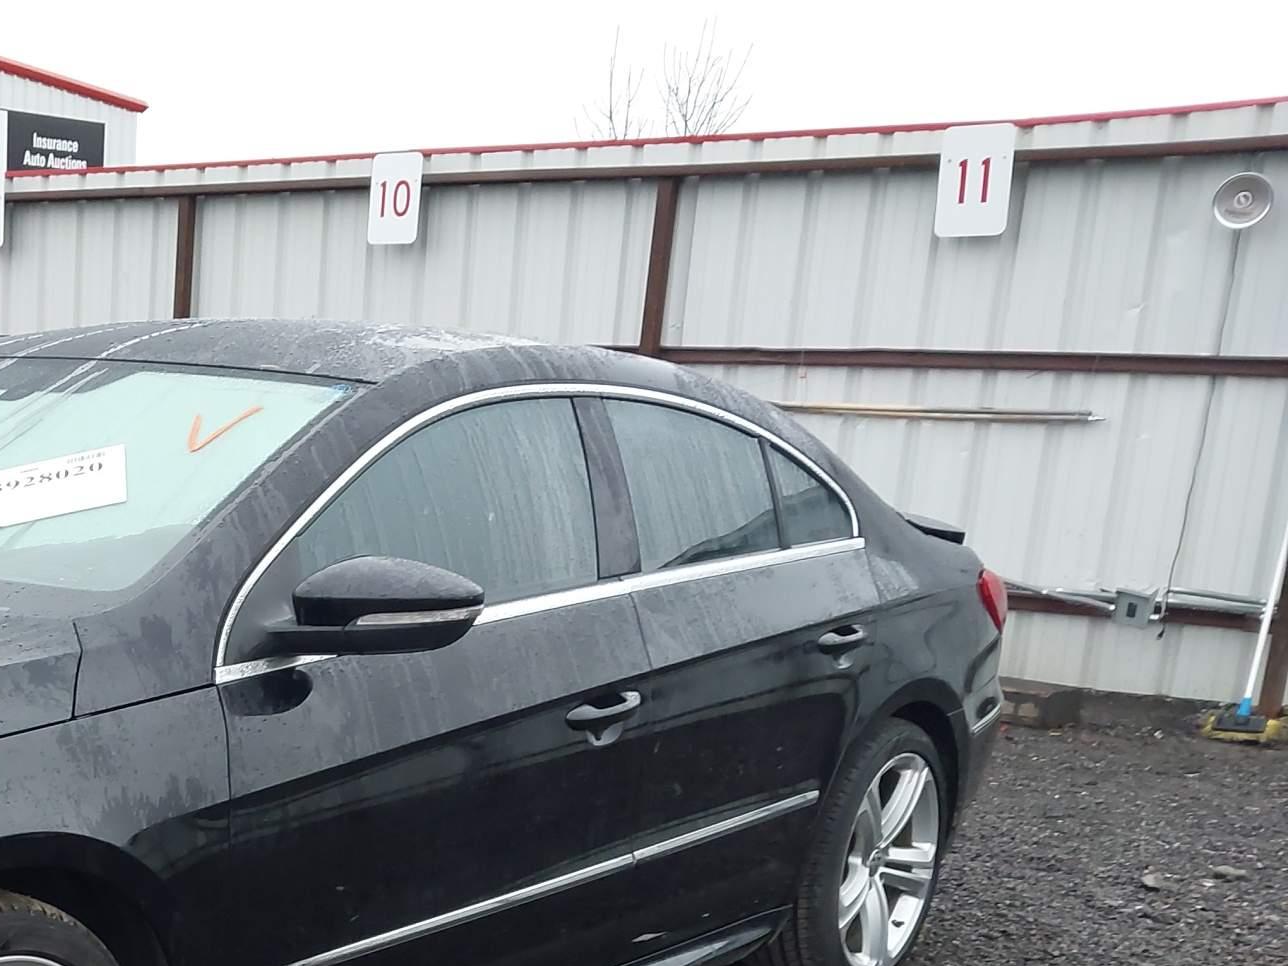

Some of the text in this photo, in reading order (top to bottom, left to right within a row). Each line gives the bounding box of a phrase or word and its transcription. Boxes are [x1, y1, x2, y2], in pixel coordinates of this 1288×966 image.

[32, 131, 79, 153] Insurance
[23, 149, 88, 170] Auto Auctions
[957, 156, 991, 204] 11
[379, 179, 411, 218] 10
